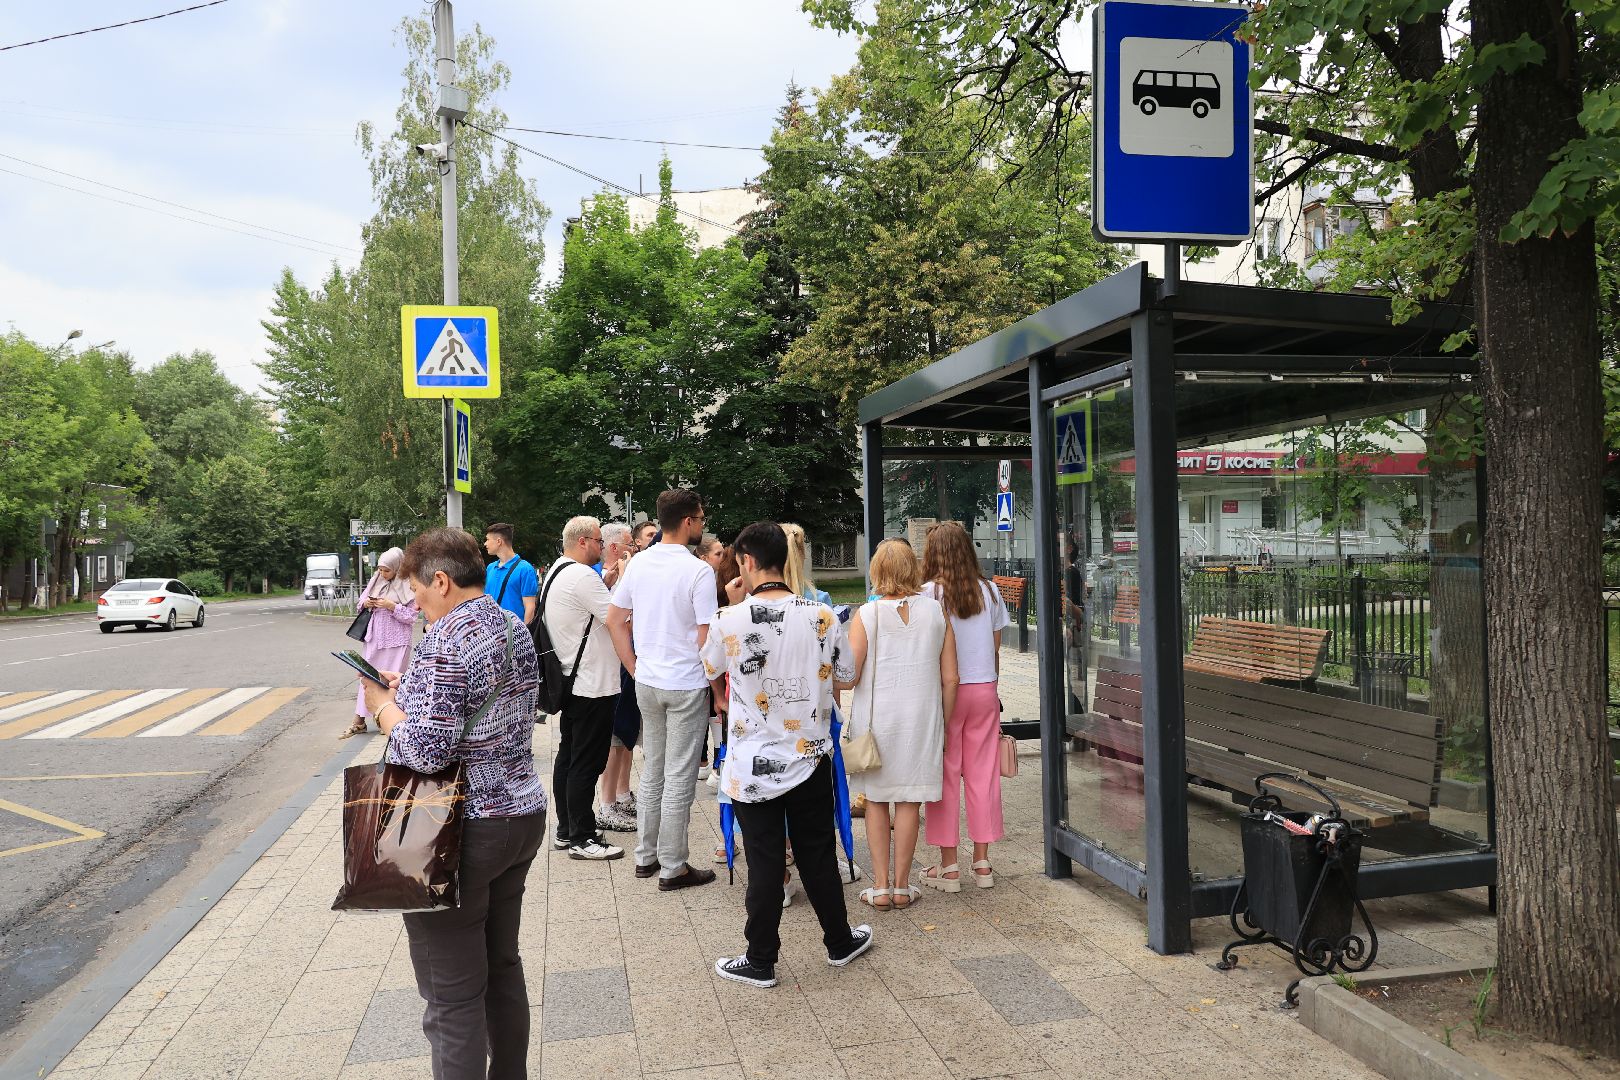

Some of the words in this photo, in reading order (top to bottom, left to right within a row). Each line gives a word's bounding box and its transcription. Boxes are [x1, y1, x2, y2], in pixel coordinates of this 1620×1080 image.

[1000, 464, 1009, 480] 40
[811, 707, 817, 722] 4
[803, 739, 825, 748] GOOD
[804, 746, 825, 755] DAYS
